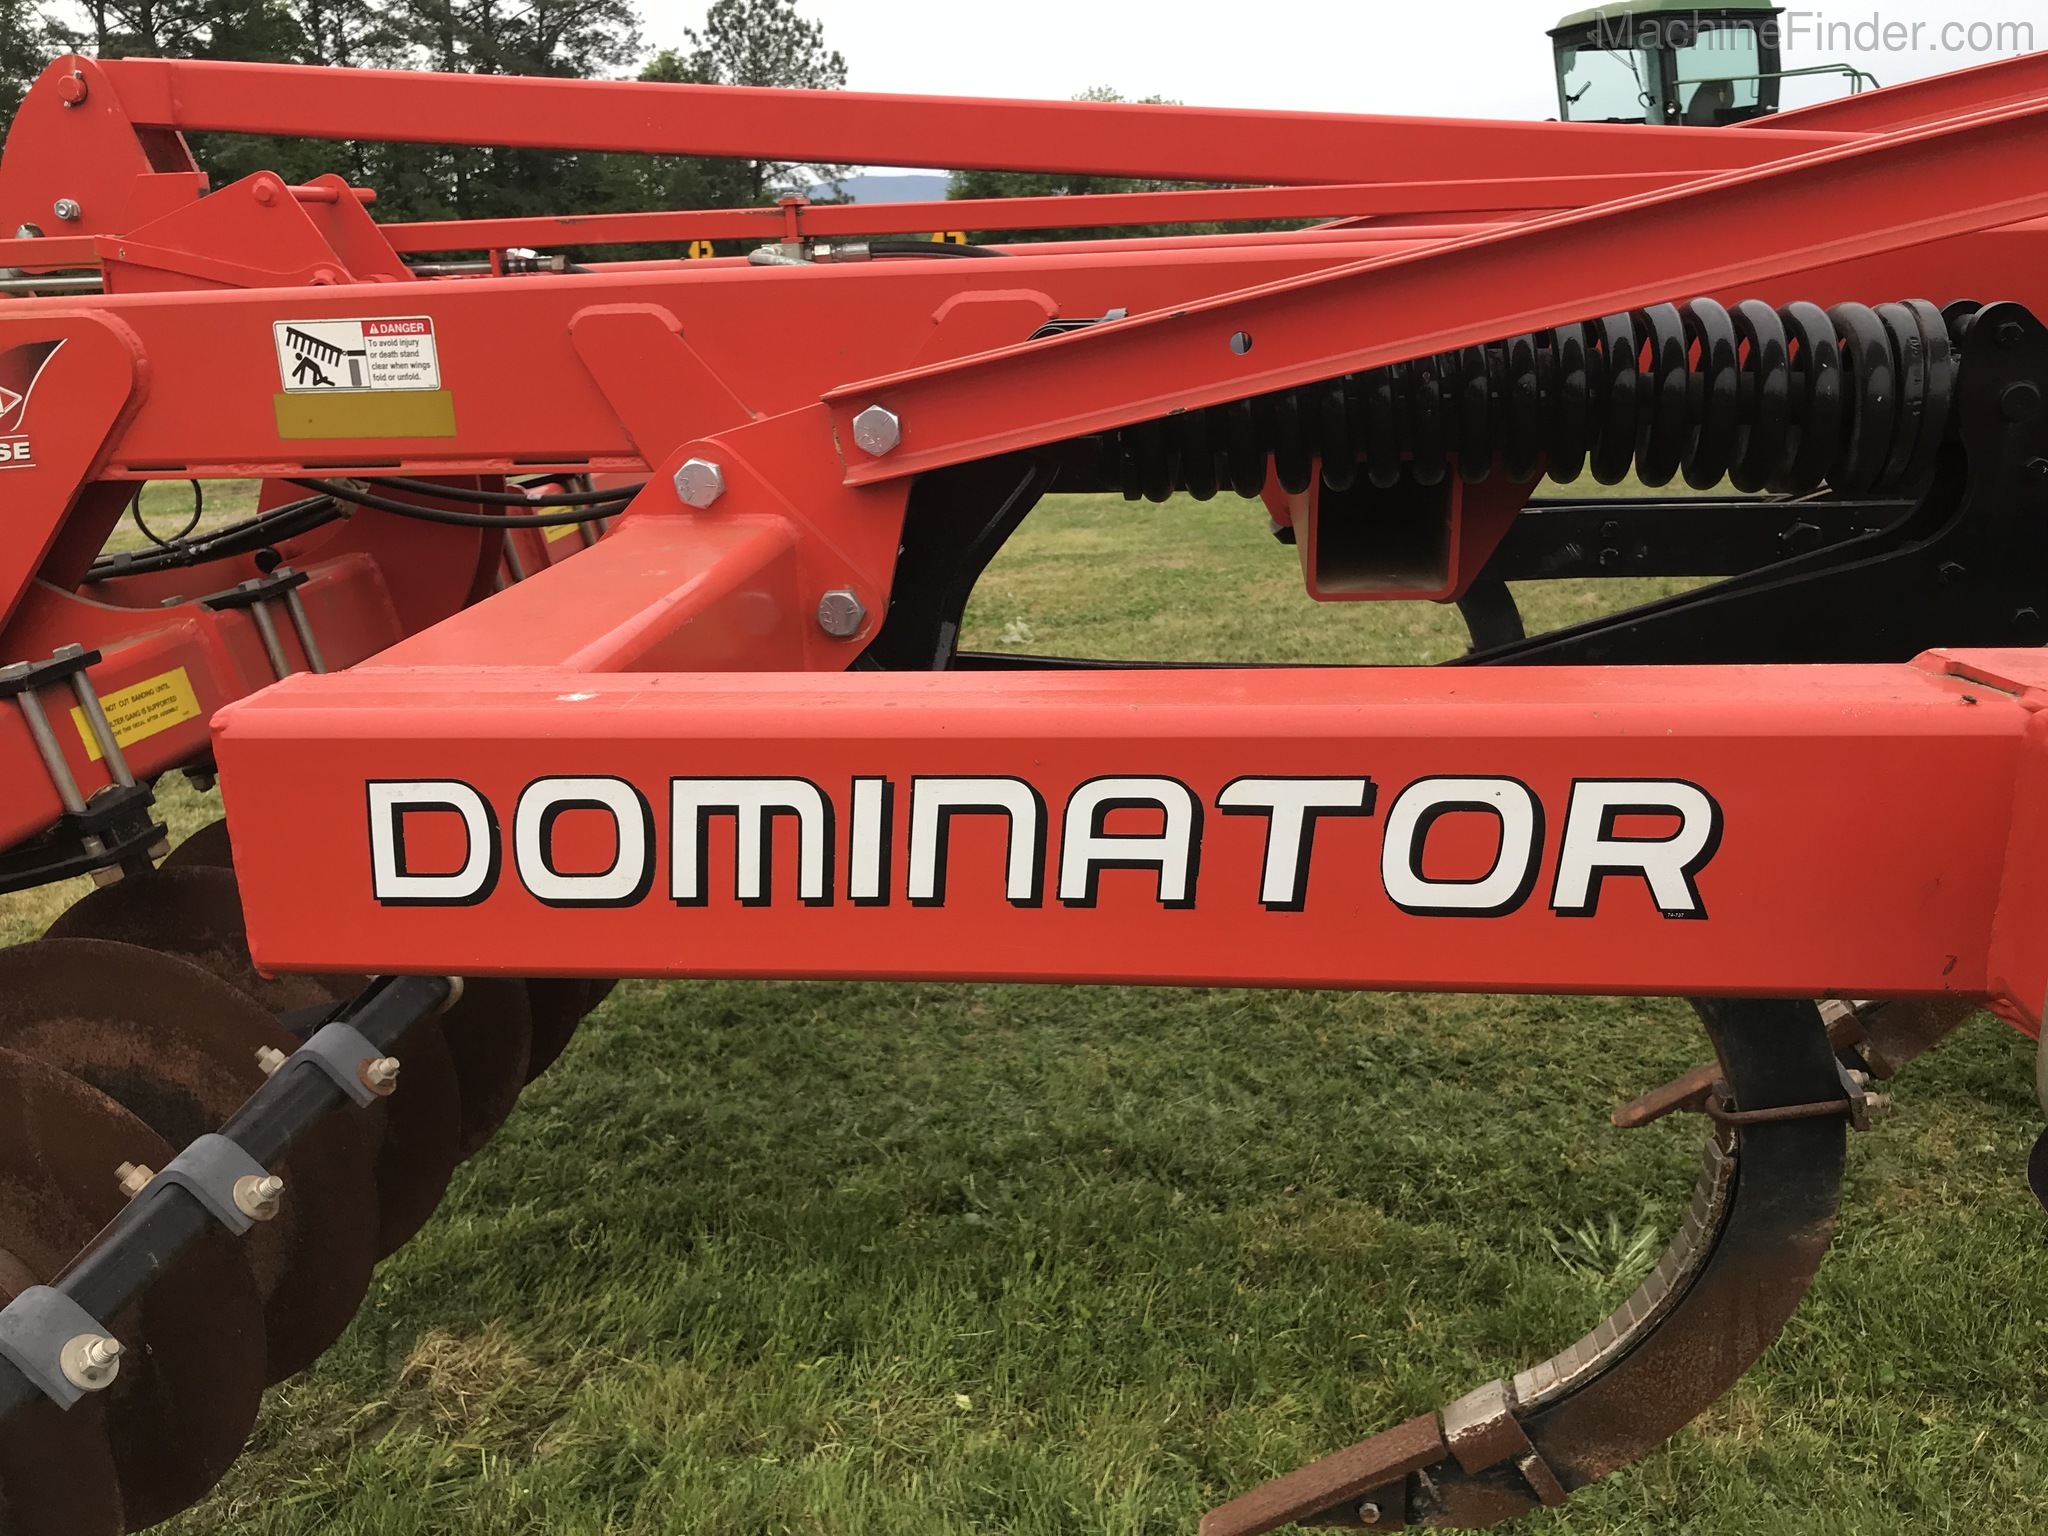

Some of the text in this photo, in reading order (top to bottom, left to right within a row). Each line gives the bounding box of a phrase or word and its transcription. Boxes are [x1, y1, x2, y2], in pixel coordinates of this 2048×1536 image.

[380, 322, 425, 334] DANGER
[368, 338, 420, 348] To avoid injury
[379, 350, 398, 358] death
[399, 349, 420, 358] stand
[371, 361, 431, 370] clear when wings
[373, 373, 387, 381] fold
[397, 372, 421, 380] unfold.
[104, 682, 170, 712] NOT CUT BANDING UNTIL
[125, 710, 141, 721] GANG
[147, 695, 177, 712] SUPPORTED
[366, 775, 1724, 919] DOMINATOR
